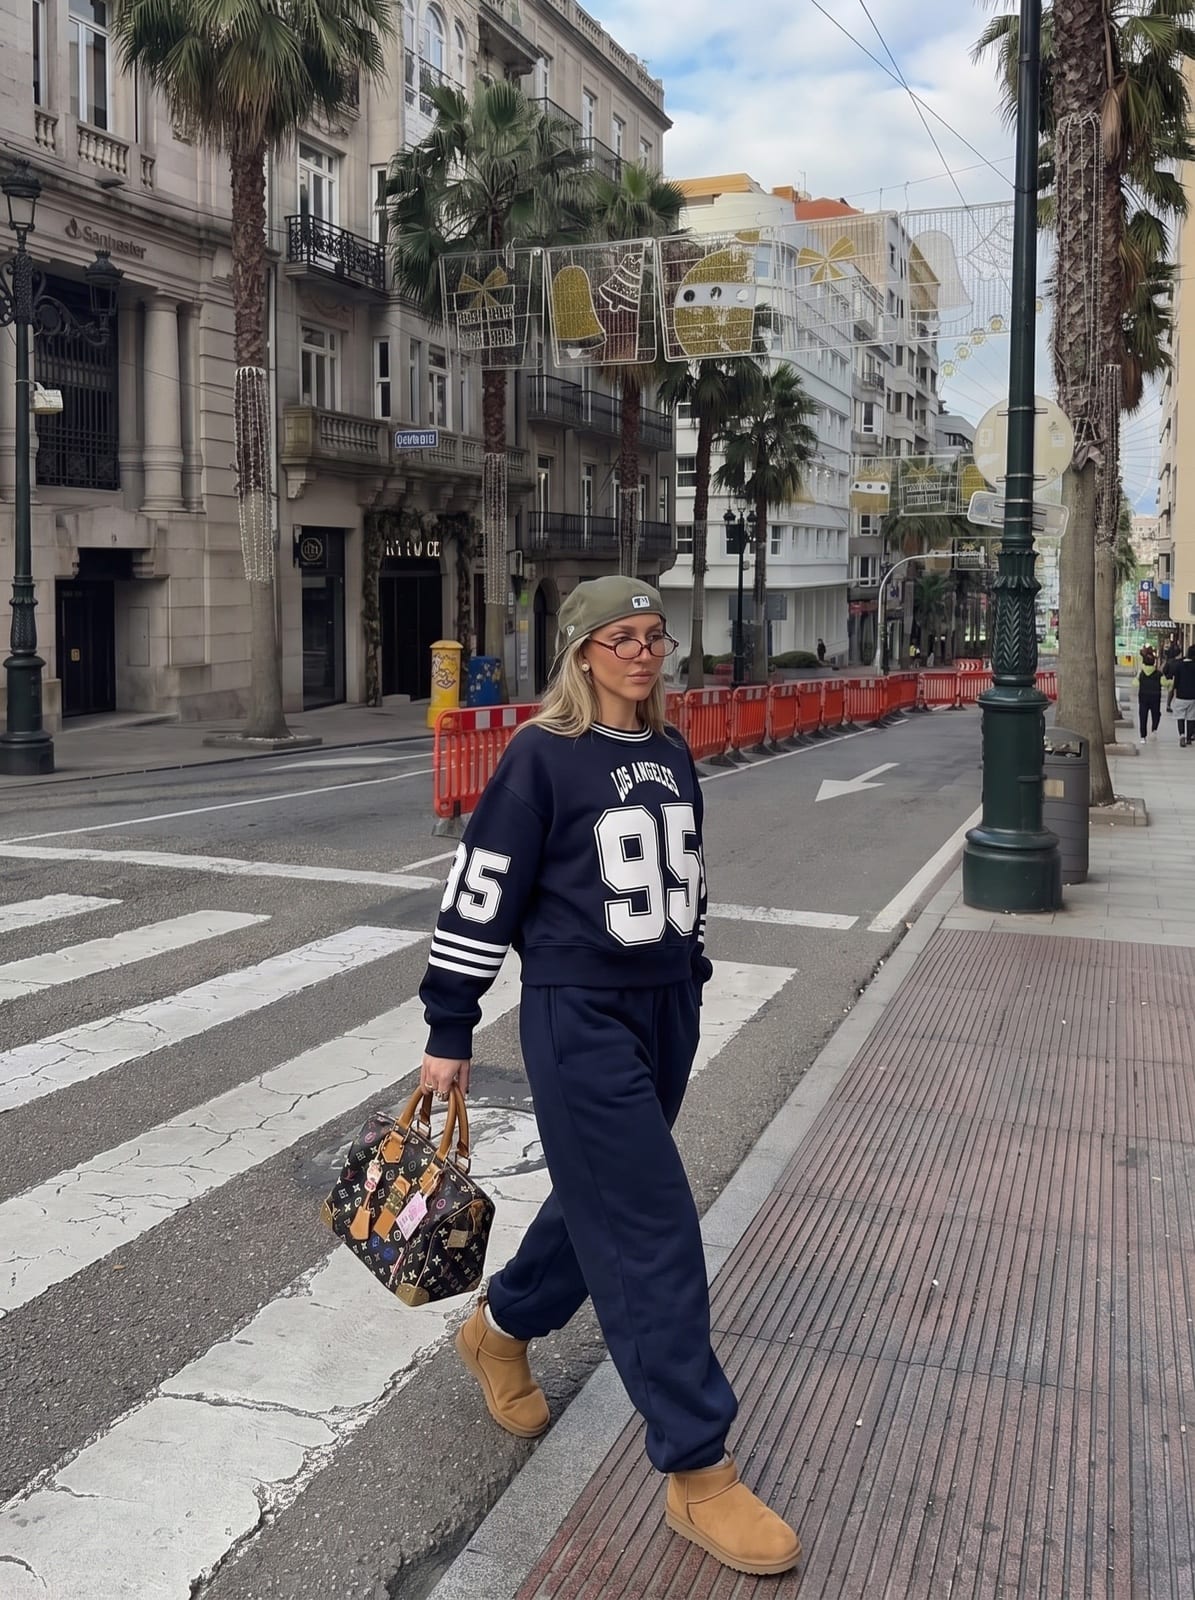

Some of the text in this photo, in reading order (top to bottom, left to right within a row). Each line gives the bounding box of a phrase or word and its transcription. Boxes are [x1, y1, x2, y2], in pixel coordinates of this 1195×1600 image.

[610, 761, 681, 803] LOS ANGELES
[593, 802, 701, 946] 95
